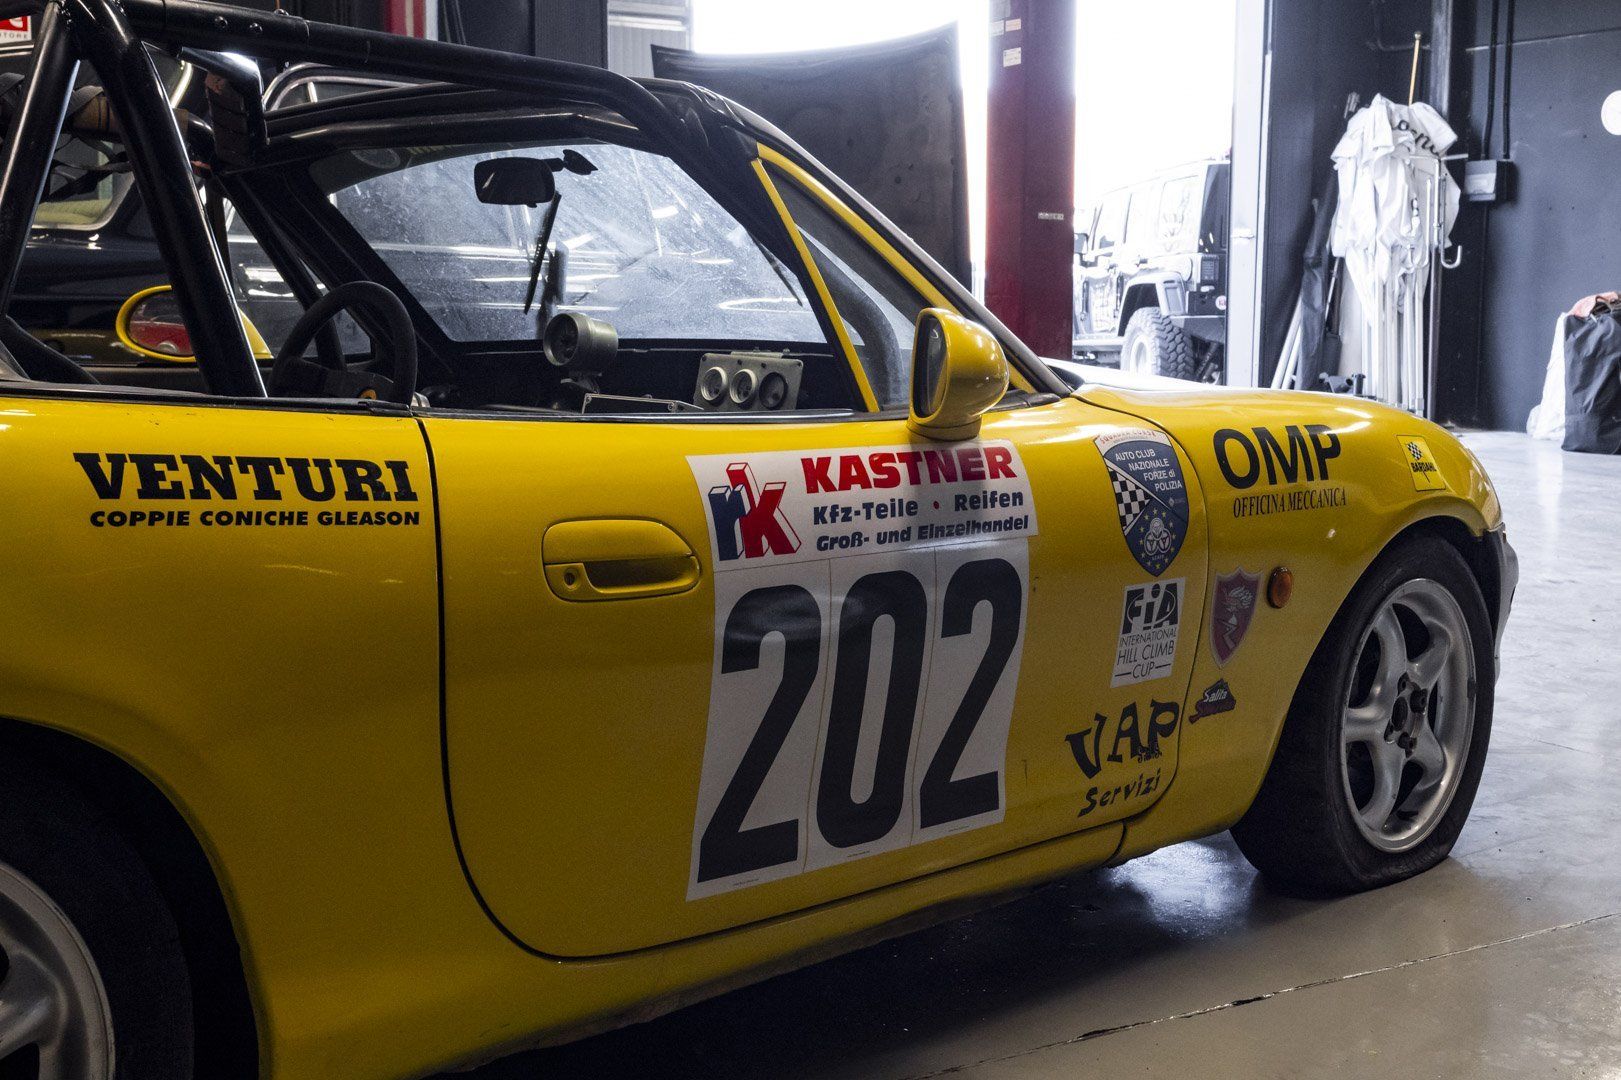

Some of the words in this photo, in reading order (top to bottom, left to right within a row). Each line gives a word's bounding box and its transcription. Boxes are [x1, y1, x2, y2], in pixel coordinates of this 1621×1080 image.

[1115, 451, 1135, 461] AUTO
[1135, 448, 1156, 459] CLUB
[1128, 458, 1170, 471] NAZIONALE
[1212, 424, 1341, 490] OMP
[73, 452, 419, 502] VENTURI
[801, 446, 1018, 495] KASTNER
[1143, 470, 1168, 482] FORZE
[1168, 468, 1176, 478] di
[1154, 480, 1183, 492] POLIZIA
[813, 498, 919, 526] Kfz-Teile
[954, 490, 1024, 512] Reifen
[1232, 494, 1285, 519] OFFICINA
[1287, 487, 1348, 511] MECCANICA
[89, 510, 190, 527] COPPIE
[199, 510, 308, 527] CONICHE
[317, 511, 420, 526] GLEASON
[876, 526, 912, 545] und
[917, 515, 1029, 540] Einzelhandel
[1120, 628, 1177, 647] INTERNATIONAL
[1116, 646, 1138, 666] HILL
[1141, 640, 1175, 660] CLIMB
[1132, 661, 1155, 679] CUP
[697, 557, 1023, 883] 202
[1064, 699, 1180, 780] VAP
[1077, 767, 1161, 818] Servizi
